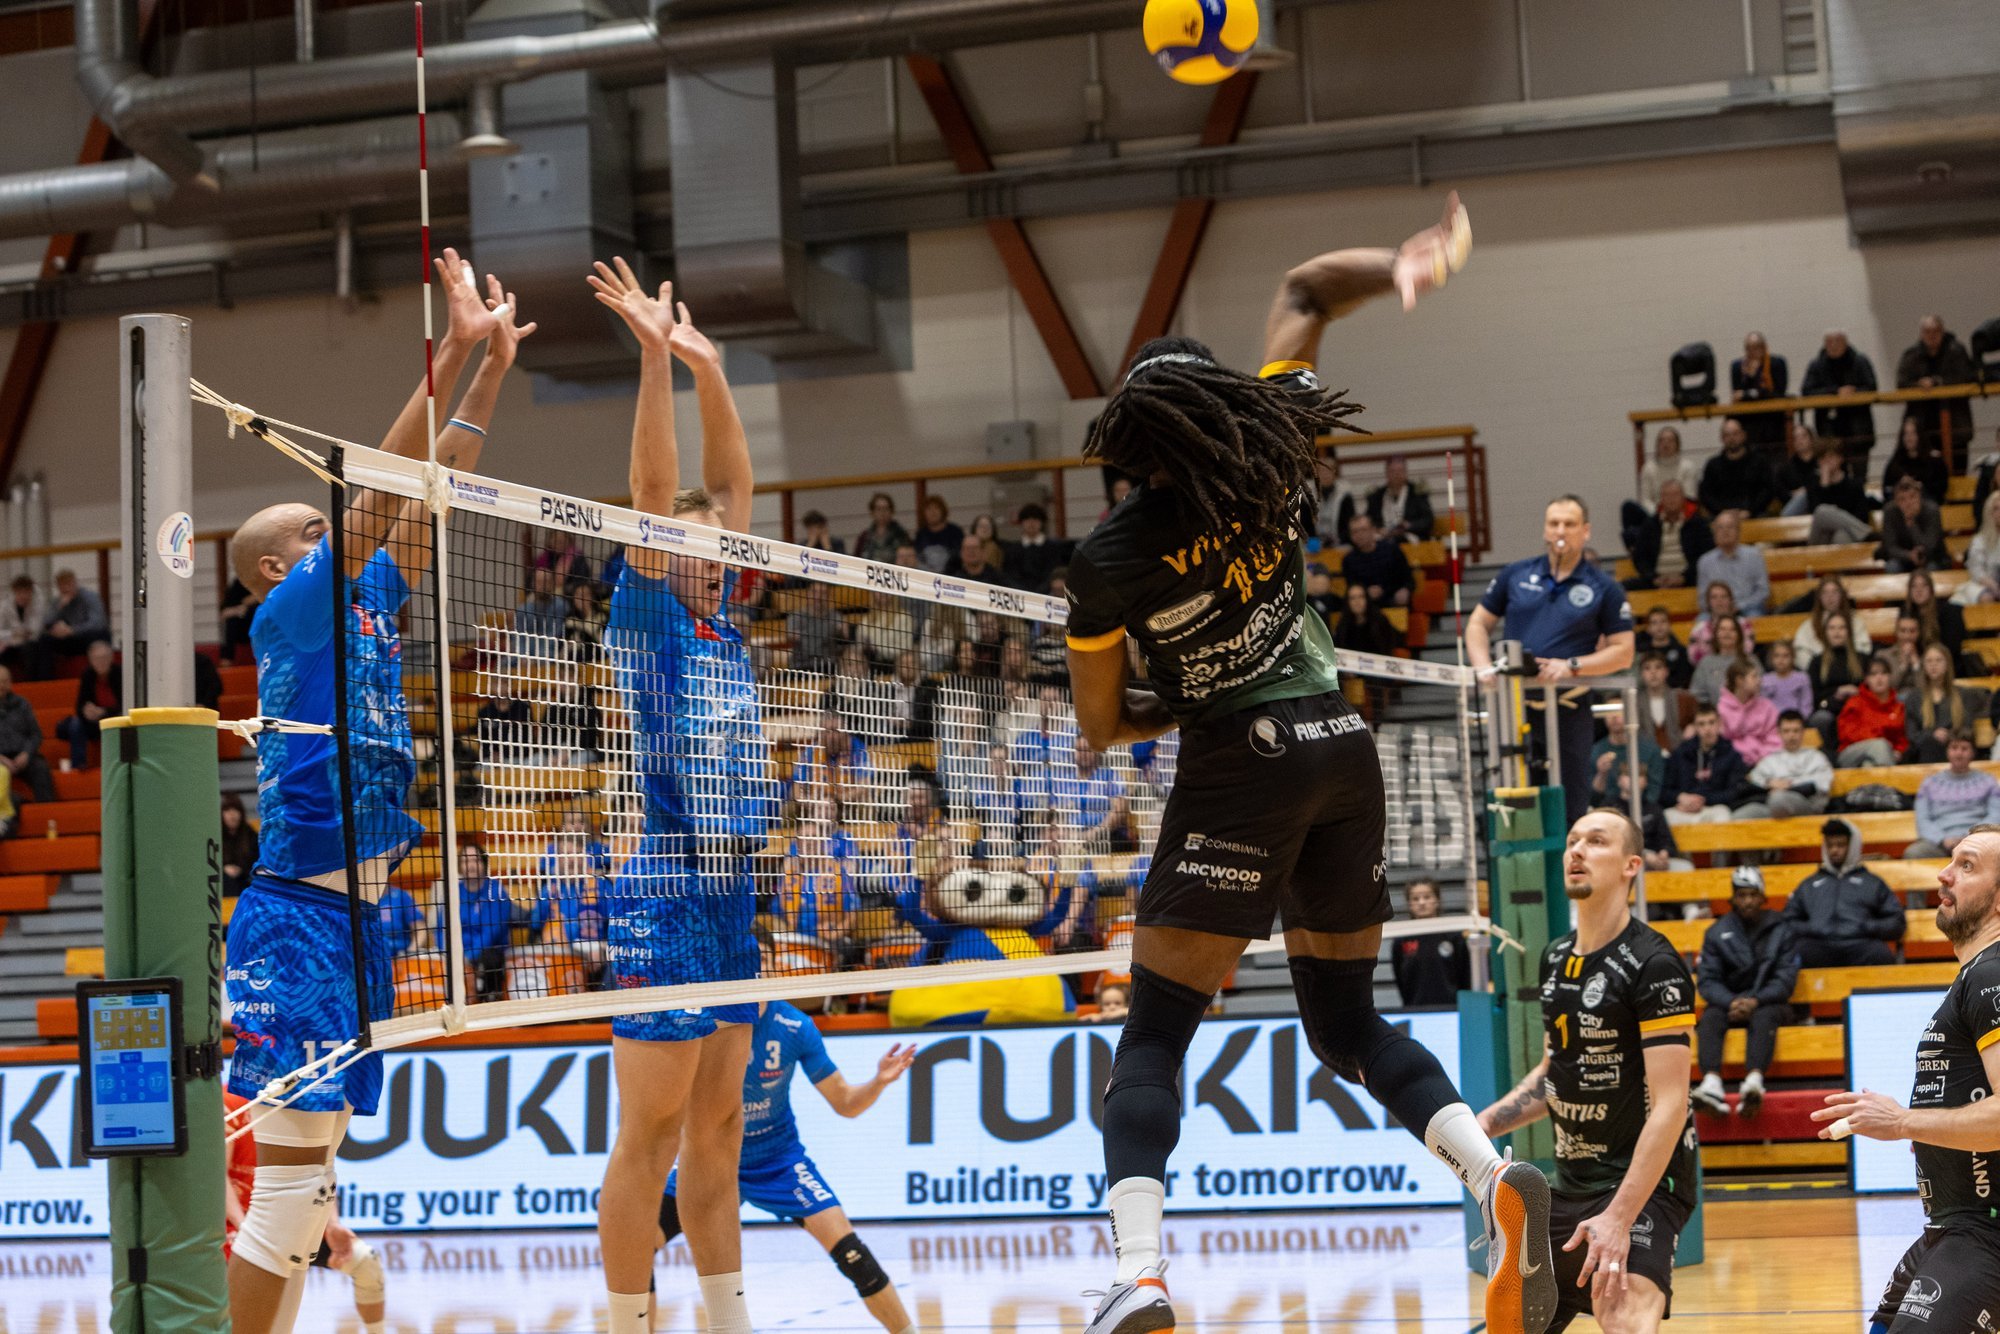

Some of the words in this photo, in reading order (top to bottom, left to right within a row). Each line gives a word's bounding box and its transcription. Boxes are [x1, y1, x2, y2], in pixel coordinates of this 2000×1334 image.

[540, 496, 603, 533] PÄRNU
[720, 535, 770, 565] PÄRNU
[866, 564, 909, 592] PÄRNU
[988, 588, 1026, 613] PÄRNU
[1294, 719, 1329, 741] ABC
[1175, 860, 1262, 883] ARCWOOD
[1554, 1013, 1568, 1049] 1
[1579, 1026, 1619, 1039] Kliima
[1580, 1013, 1604, 1029] City
[303, 1040, 343, 1079] 17
[764, 1040, 781, 1070] 3
[1436, 1144, 1461, 1170] CRAFT
[906, 1164, 1073, 1209] Building
[1086, 1170, 1179, 1209] yr
[1194, 1162, 1419, 1198] tomorrow.
[0, 1199, 92, 1225] rrow.
[417, 1190, 500, 1224] your
